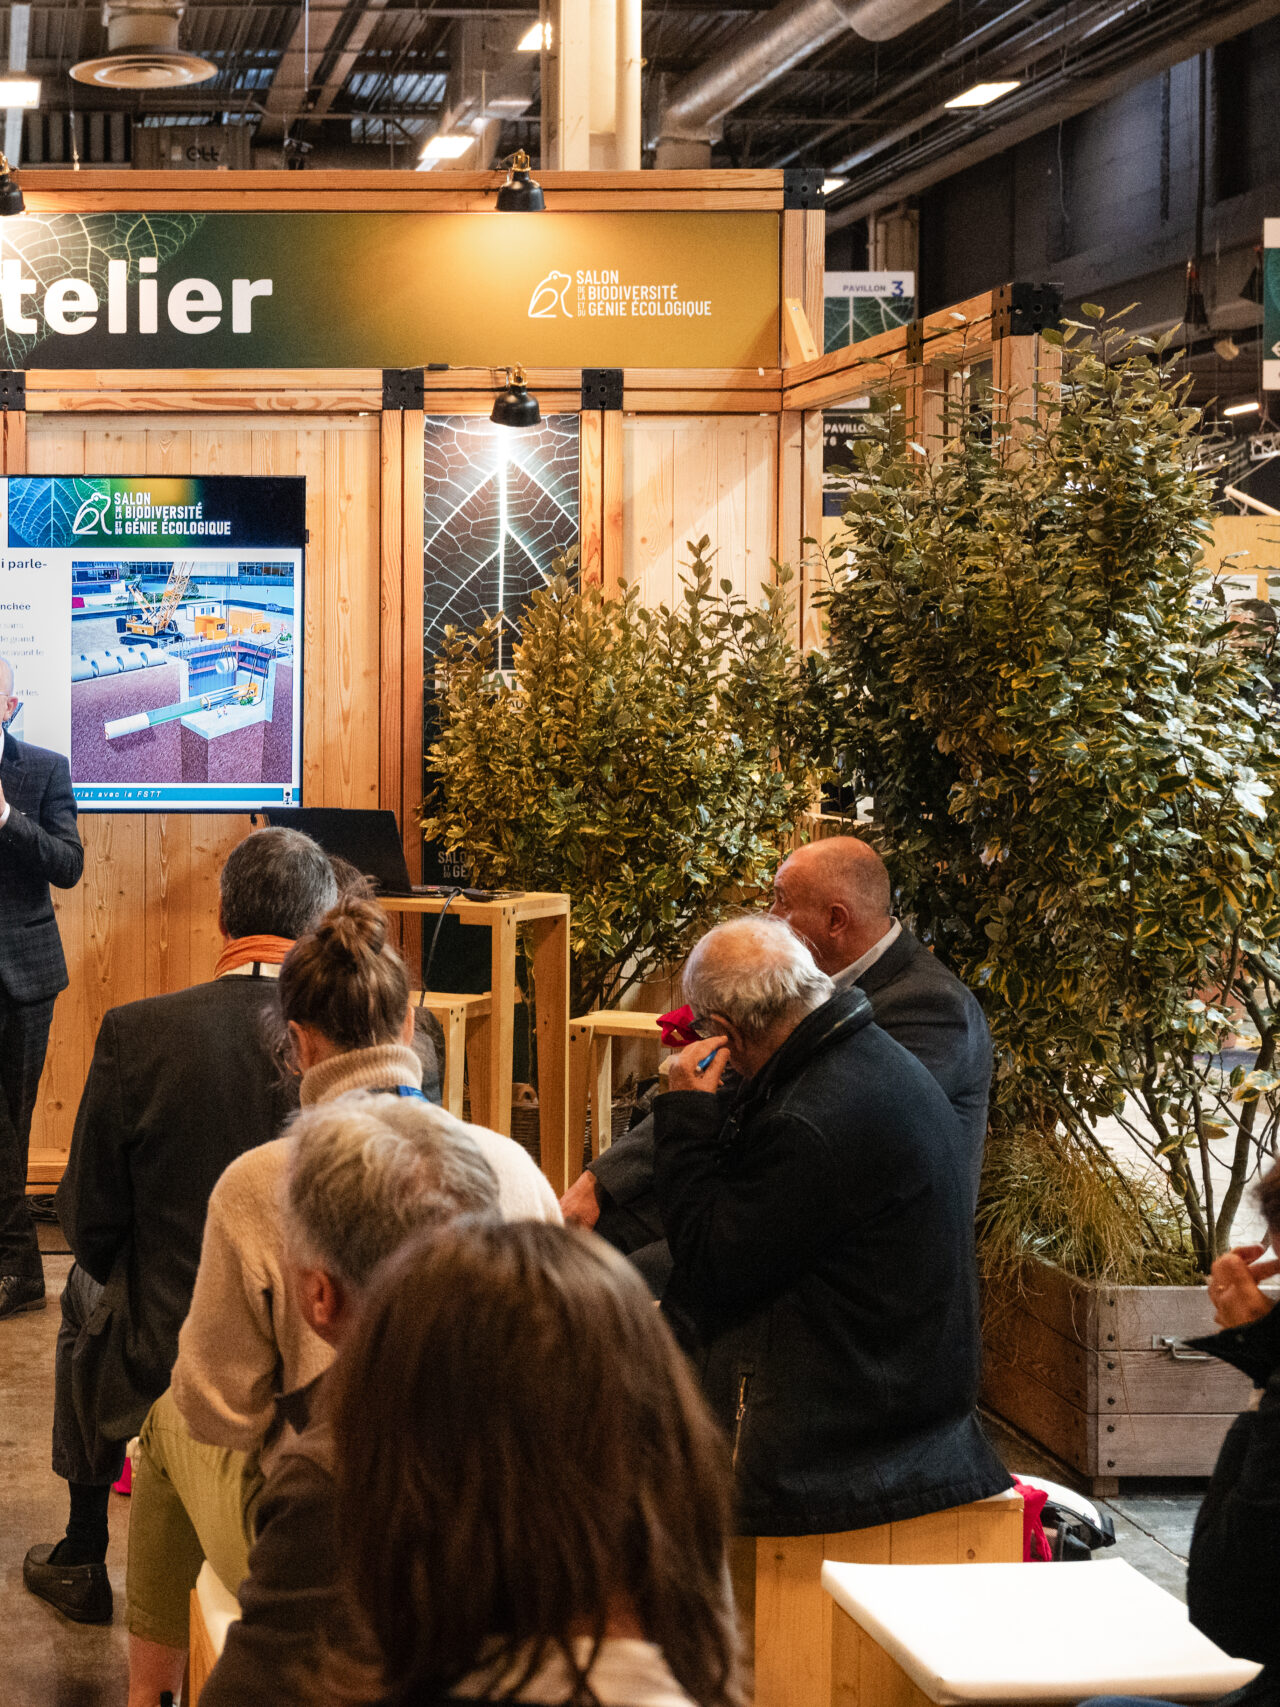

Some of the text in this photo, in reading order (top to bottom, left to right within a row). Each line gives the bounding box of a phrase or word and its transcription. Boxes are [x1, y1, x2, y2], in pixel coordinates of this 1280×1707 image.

[576, 270, 619, 284] SALON
[588, 283, 678, 300] BIODIVERSITÉ
[891, 280, 904, 298] 3
[588, 299, 712, 318] GÉNIE ÉCOLOGIQUE
[114, 492, 151, 505] SALON
[125, 502, 203, 519] BIODIVERSITÉ
[125, 518, 231, 535] GÉNIE ÉCOLOGIQUE
[8, 557, 47, 572] parle-
